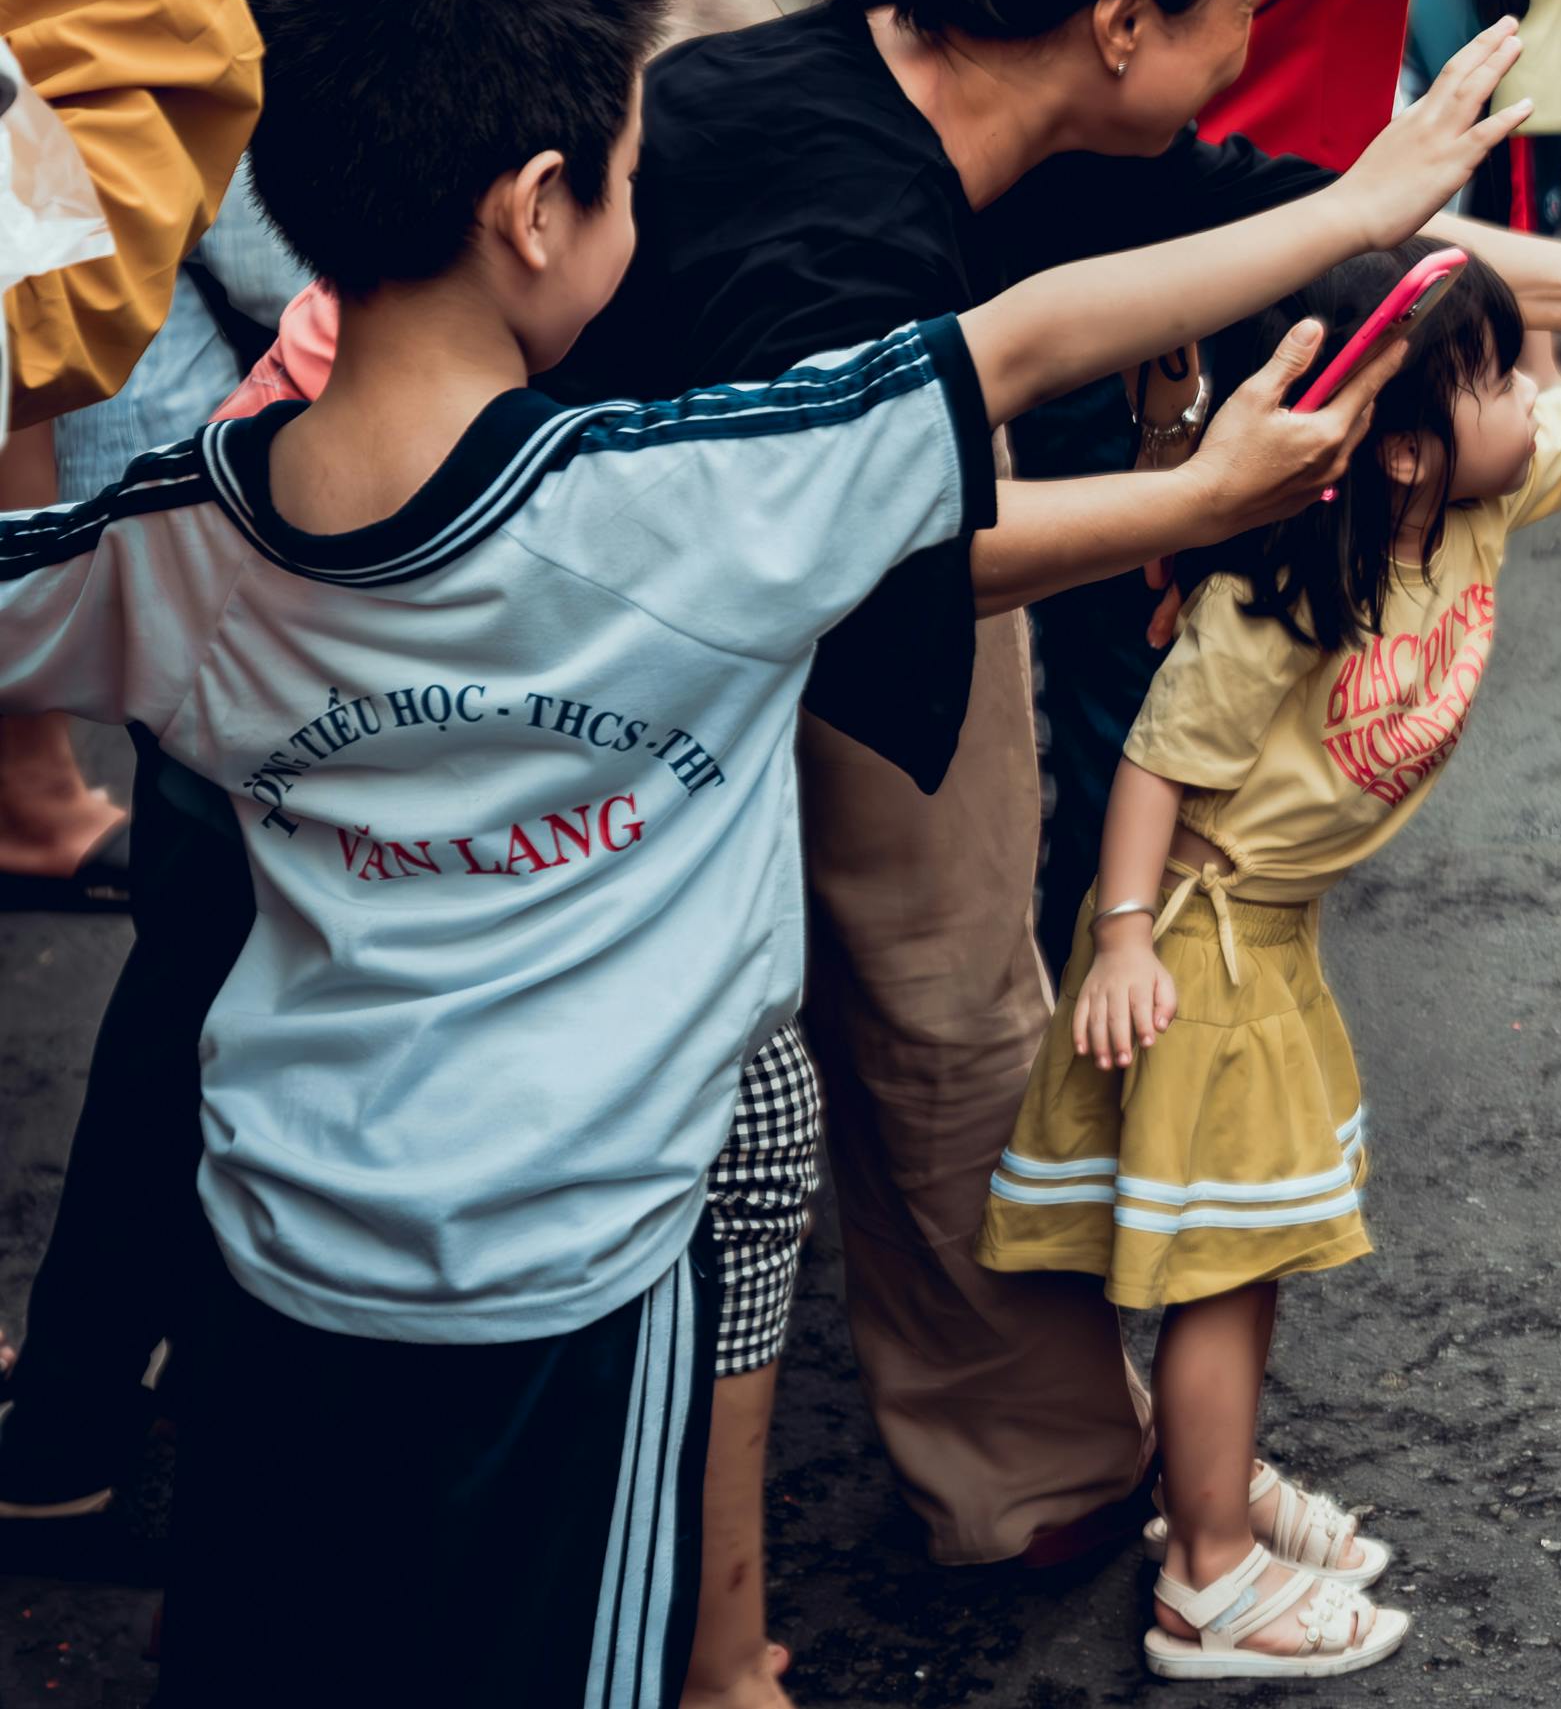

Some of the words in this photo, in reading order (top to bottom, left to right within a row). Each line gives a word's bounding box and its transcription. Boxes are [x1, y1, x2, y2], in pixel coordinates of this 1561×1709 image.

[1323, 582, 1494, 729] BLACPINK
[243, 751, 310, 838] TỜNG
[385, 684, 486, 732] HỌC
[524, 692, 648, 752] THCS
[652, 728, 726, 797] THT
[337, 824, 438, 880] VĂN
[449, 793, 645, 876] LANG
